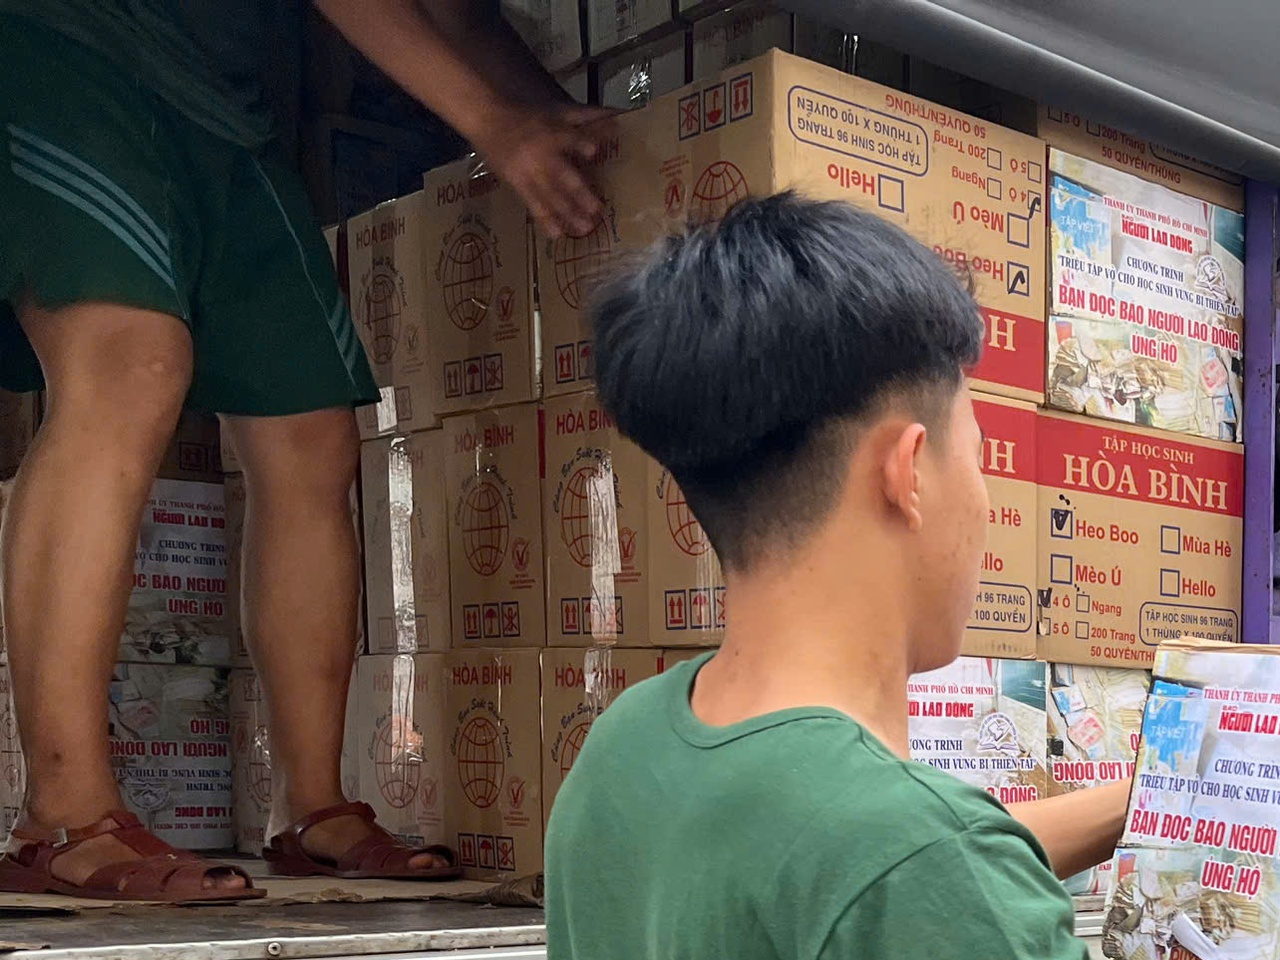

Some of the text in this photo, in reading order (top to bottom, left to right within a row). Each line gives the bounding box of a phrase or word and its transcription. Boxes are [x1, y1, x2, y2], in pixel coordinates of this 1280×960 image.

[842, 109, 859, 126] 100
[864, 118, 870, 129] X
[798, 118, 921, 166] TẬP HỌC SINH 96 TRANG
[874, 122, 912, 143] THÙNG
[975, 127, 986, 139] 50
[1102, 126, 1145, 154] 200 Trang
[934, 130, 986, 160] 200 Trang
[1102, 146, 1112, 159] 50
[952, 166, 985, 189] Ngang
[1021, 162, 1026, 173] 5
[828, 163, 875, 195] Hello
[437, 184, 465, 206] HÒA
[971, 207, 1003, 233] Mèo
[356, 225, 378, 249] HÒA
[1152, 229, 1168, 245] LAO
[973, 259, 1003, 281] Heo
[1118, 272, 1135, 285] CHO
[1137, 277, 1154, 291] HỌC
[1155, 280, 1173, 296] SINH
[1059, 285, 1085, 310] BẠN
[1188, 321, 1208, 340] LAO
[556, 405, 587, 436] HÒA
[454, 422, 515, 454] HÒA BÌNH
[1102, 434, 1195, 465] TẬP HỌC SINH
[1063, 450, 1139, 496] HÒA
[1148, 464, 1228, 510] BÌNH
[1001, 506, 1021, 526] Hè
[1076, 519, 1139, 545] Heo Boo
[1182, 535, 1232, 558] Mùa Hè
[1075, 564, 1106, 585] Mèo
[1182, 578, 1216, 598] Hello
[985, 593, 1025, 605] 96 TRANG
[1053, 594, 1070, 608] 4 Ô
[1092, 601, 1122, 616] Ngang
[975, 609, 990, 620] 100
[1146, 609, 1233, 627] TẬP HỌC SINH 96 TRANG
[1053, 622, 1069, 634] 5 Ô
[1091, 627, 1135, 644] 200 Trang
[1153, 626, 1181, 639] THÙNG
[1091, 646, 1101, 657] 50
[452, 660, 512, 687] HÒA BÌNH
[555, 666, 585, 688] HÒA
[975, 687, 993, 695] MINH
[923, 701, 942, 717] LAO
[1254, 714, 1278, 734] LAO
[151, 741, 177, 756] LAO
[929, 758, 950, 769] SINH
[1201, 781, 1221, 797] CHO
[1222, 785, 1242, 802] HỌC
[1244, 787, 1270, 804] SINH
[1131, 809, 1159, 840] BẠN
[1161, 814, 1192, 844] ĐỌC
[1194, 816, 1226, 847] BÁO
[1228, 823, 1278, 856] NGƯỜI
[1236, 866, 1261, 900] HỘ
